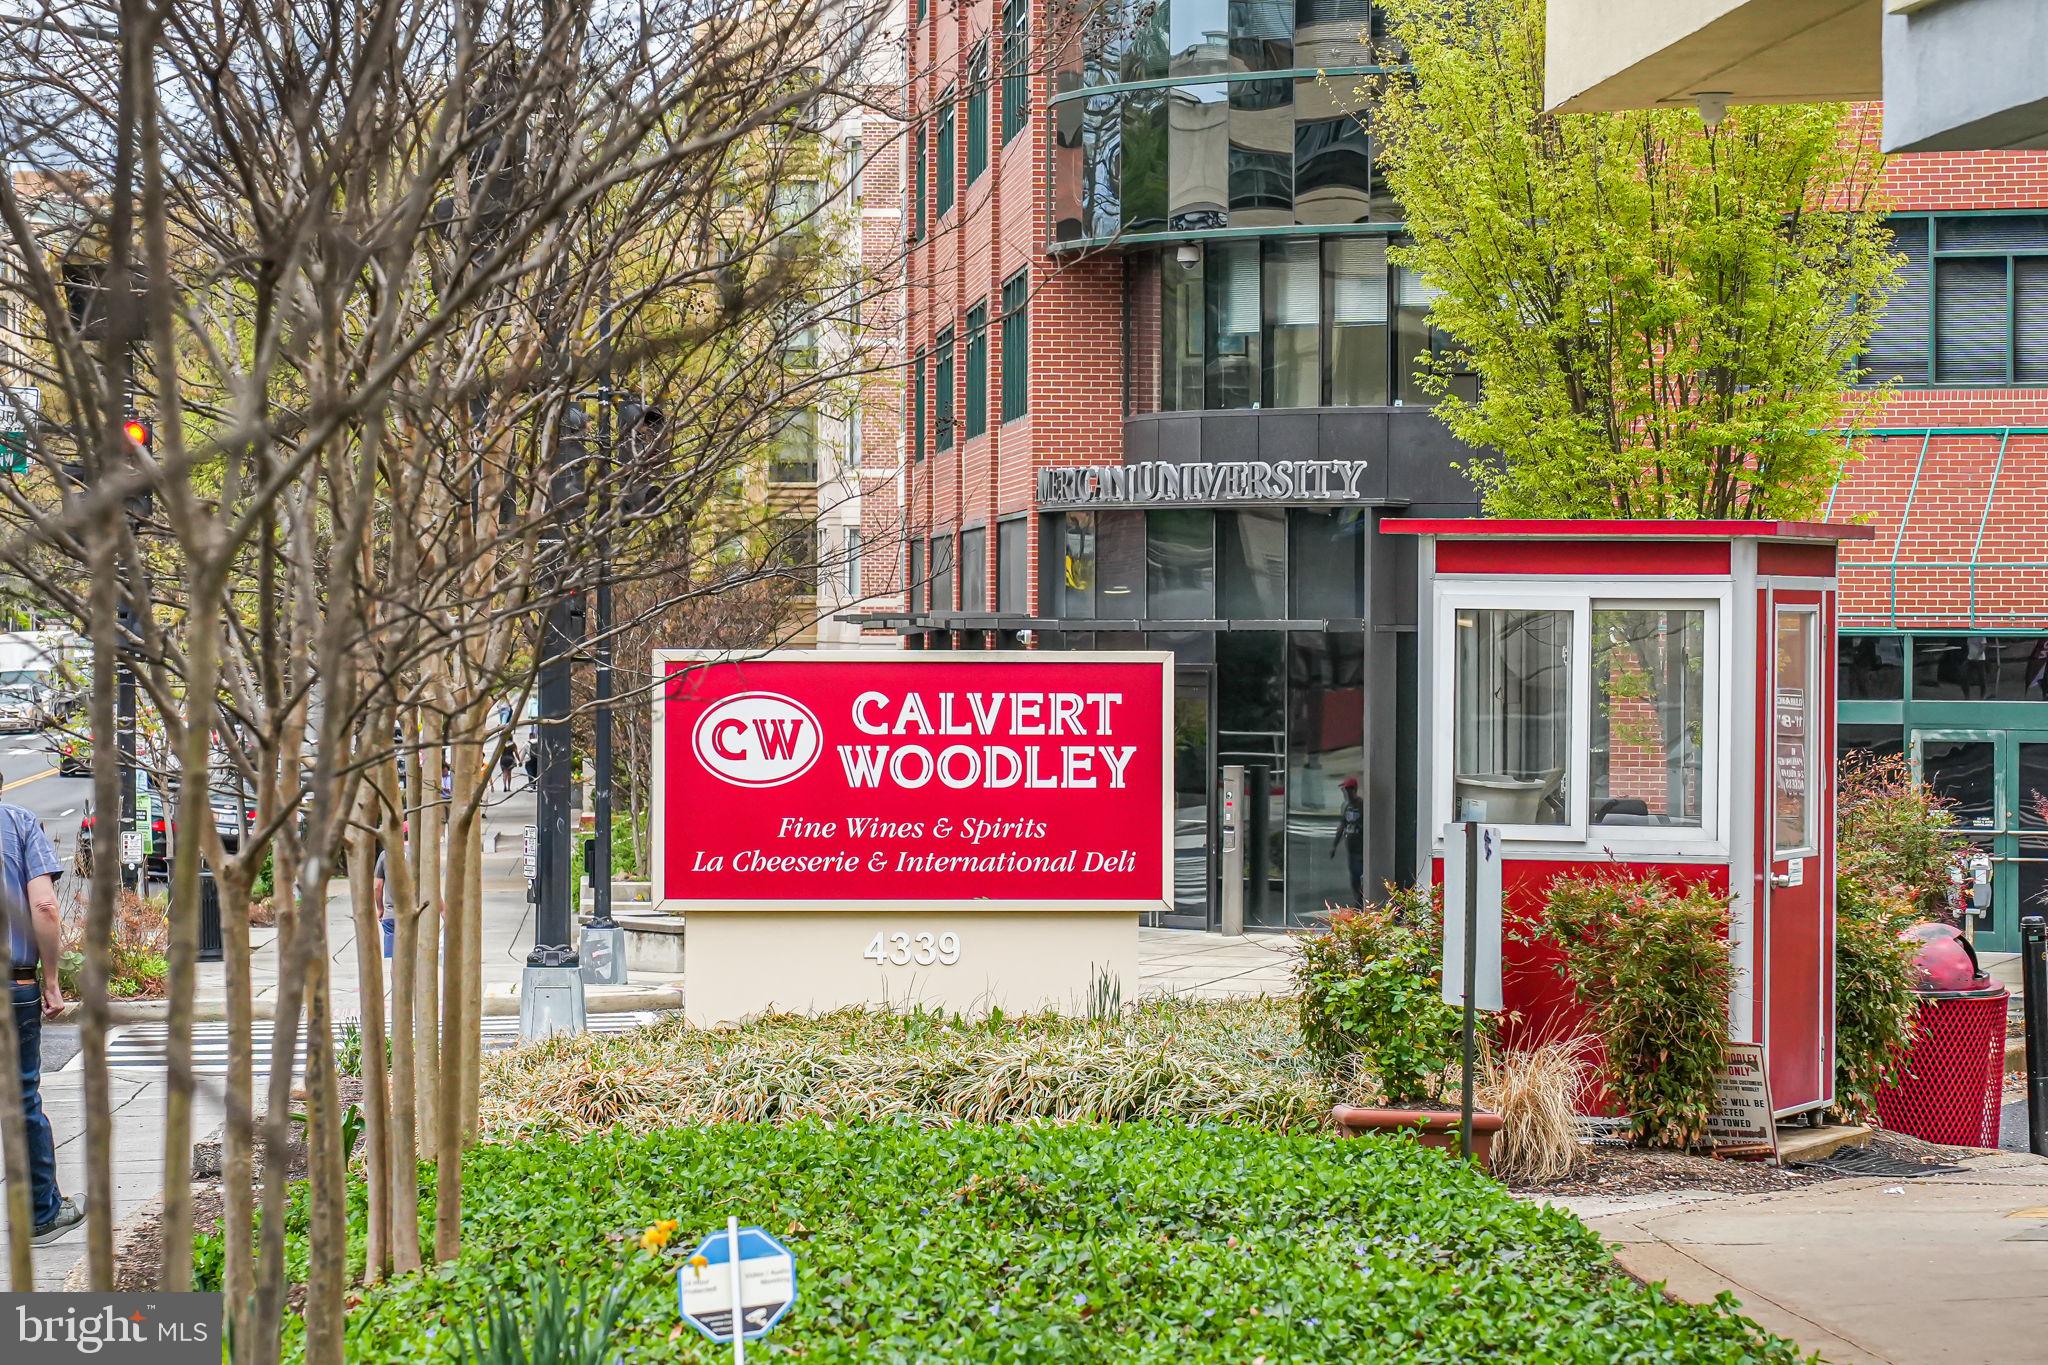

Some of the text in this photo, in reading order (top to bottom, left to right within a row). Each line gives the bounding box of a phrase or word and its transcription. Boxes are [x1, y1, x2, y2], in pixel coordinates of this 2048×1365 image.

[1035, 461, 1368, 503] MERICAN UNIVERSITY
[851, 690, 1123, 736] CALVERT
[712, 718, 804, 761] CW
[837, 744, 1137, 790] WOODLEY
[776, 816, 1047, 844] Fine Wines & Spirits
[691, 849, 1136, 873] La Cheeserie & International Deli
[863, 930, 962, 966] 4339
[1728, 1065, 1750, 1077] ONLY
[1730, 1098, 1751, 1107] WILL
[1754, 1099, 1765, 1108] BE
[1704, 1116, 1751, 1128] ND TOWED
